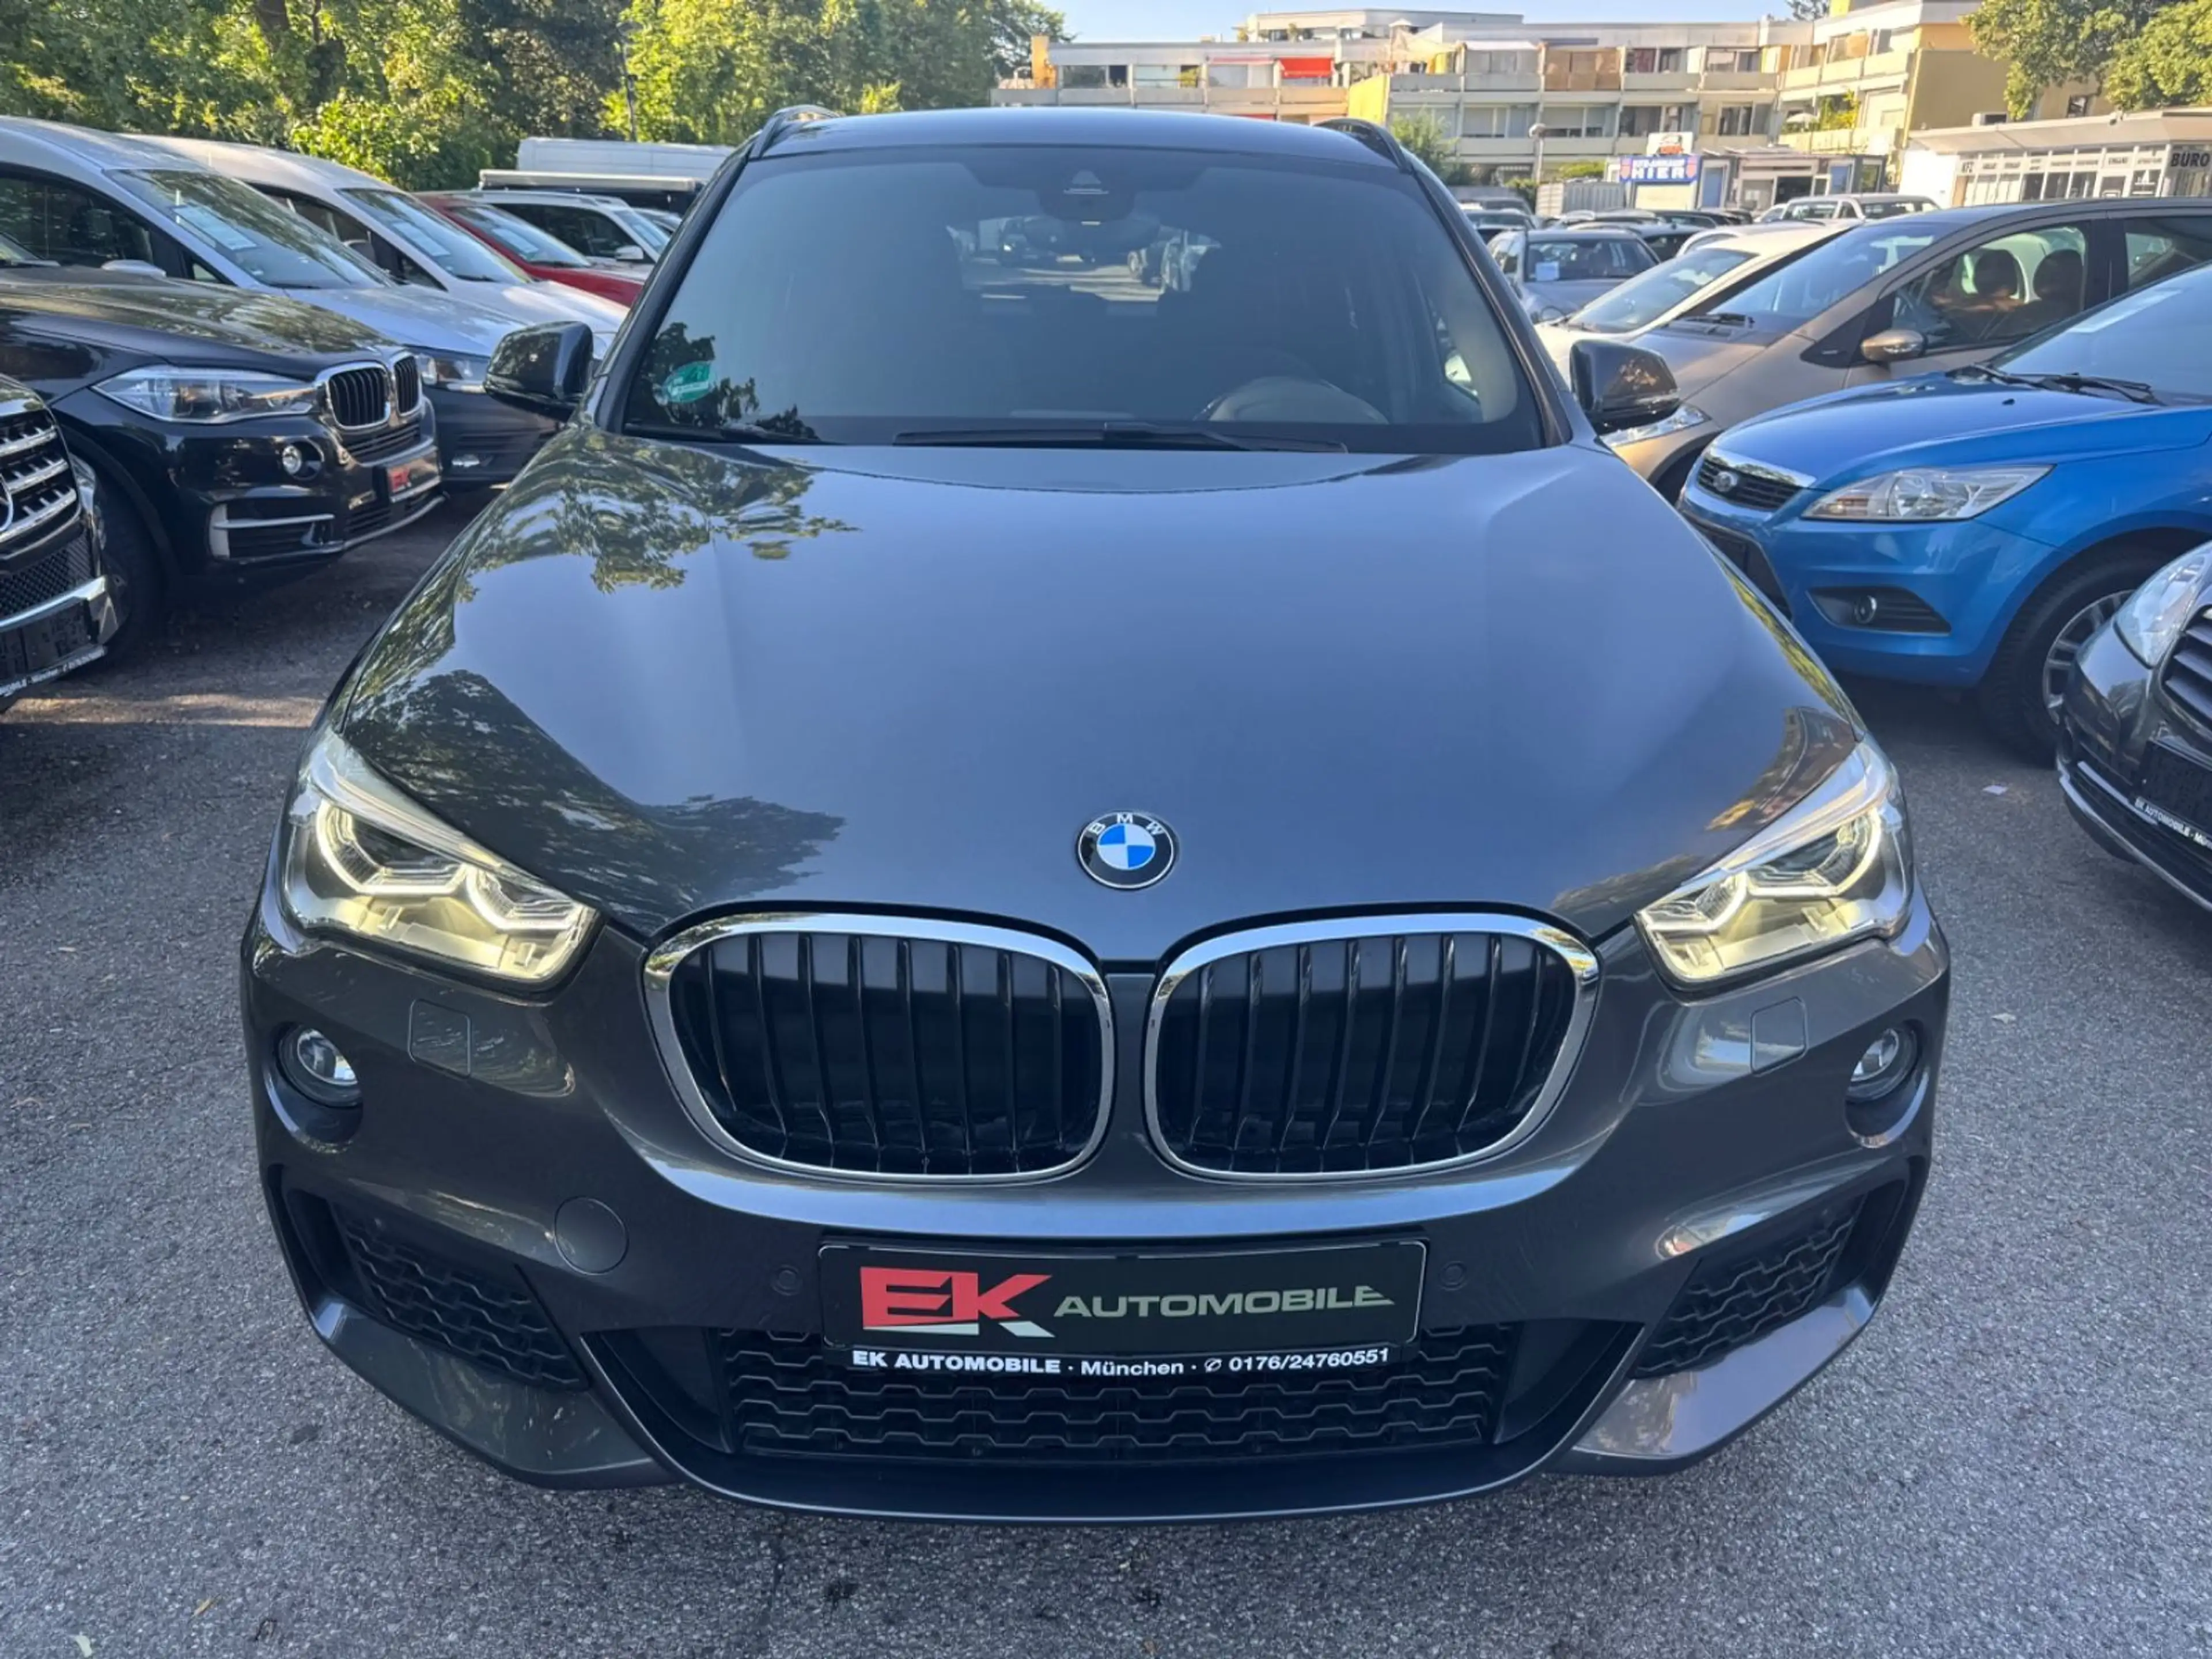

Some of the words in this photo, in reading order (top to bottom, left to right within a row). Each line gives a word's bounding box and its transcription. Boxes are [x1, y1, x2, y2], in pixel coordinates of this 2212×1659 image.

[2171, 151, 2210, 167] BÜRO
[1631, 167, 1685, 179] HIER
[1088, 812, 1164, 835] BMW
[860, 1267, 1055, 1338] EK
[1054, 1286, 1395, 1317] AUTOMOBILE
[853, 1350, 888, 1367] EK
[894, 1354, 1061, 1373] AUTOMOBILE
[1081, 1360, 1184, 1376] München
[1229, 1348, 1389, 1372] 0176/24760551
